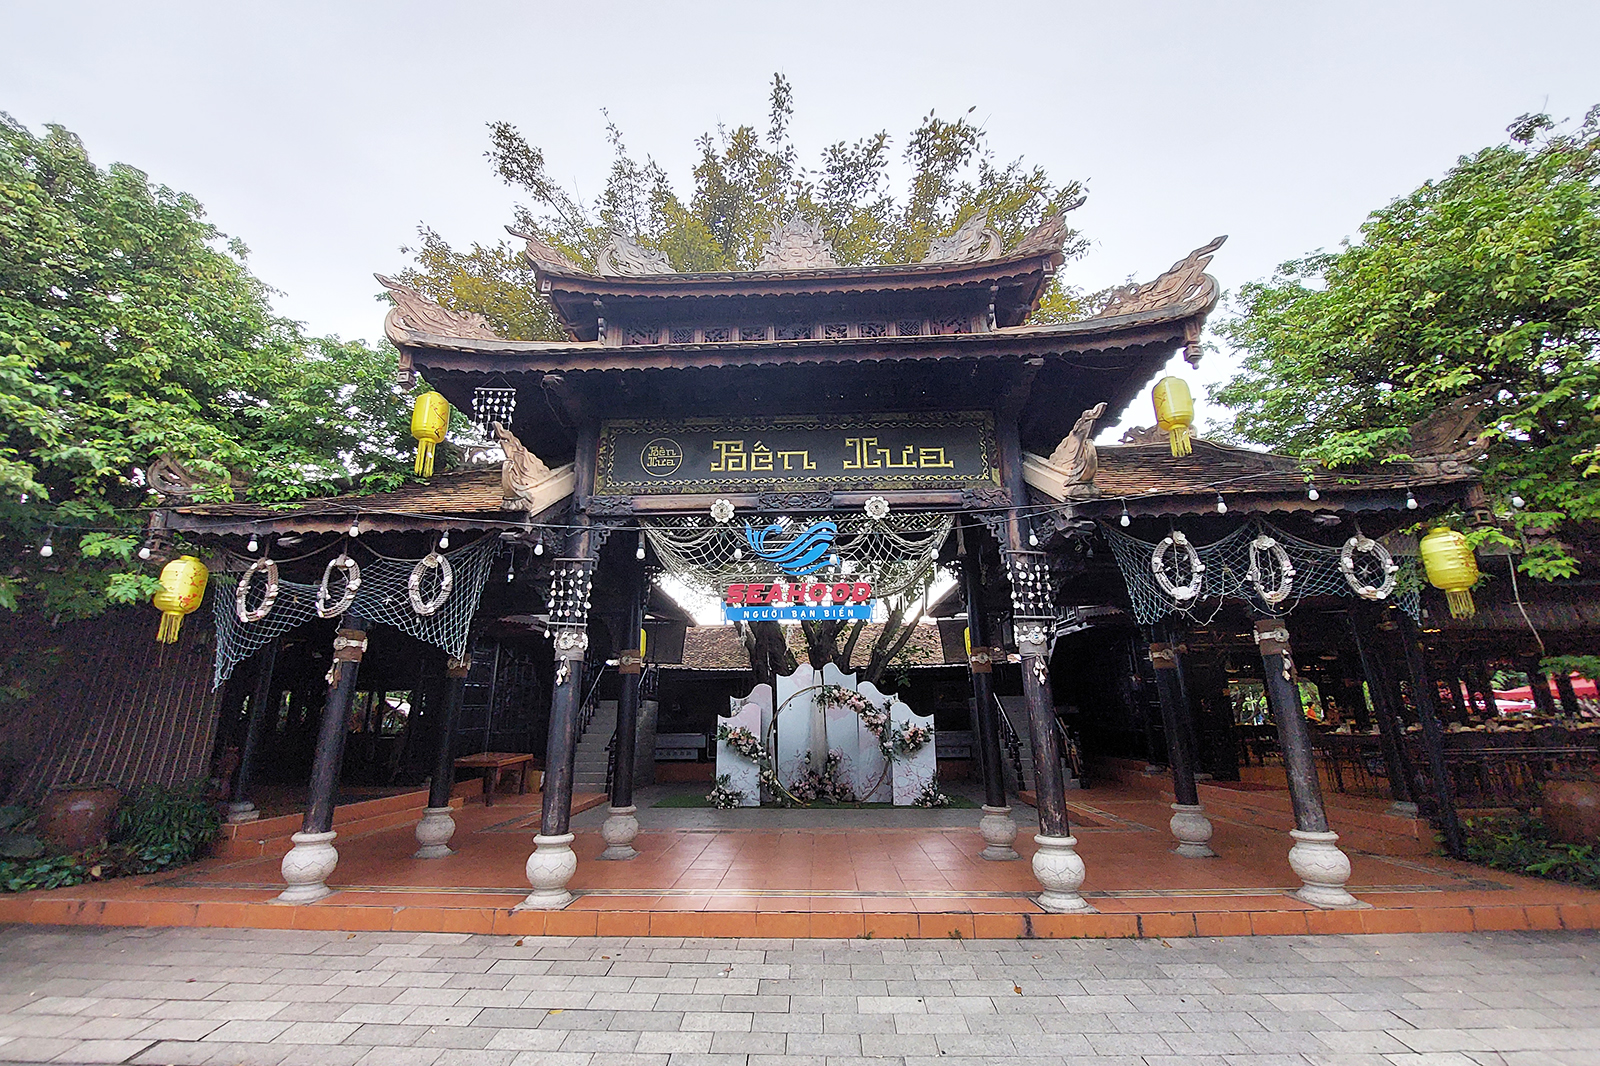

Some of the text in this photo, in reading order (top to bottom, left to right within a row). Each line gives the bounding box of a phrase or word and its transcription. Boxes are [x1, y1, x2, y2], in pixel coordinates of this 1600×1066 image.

[843, 437, 954, 470] Xưa
[726, 582, 872, 604] SEAHOOD
[791, 609, 816, 620] BẠN
